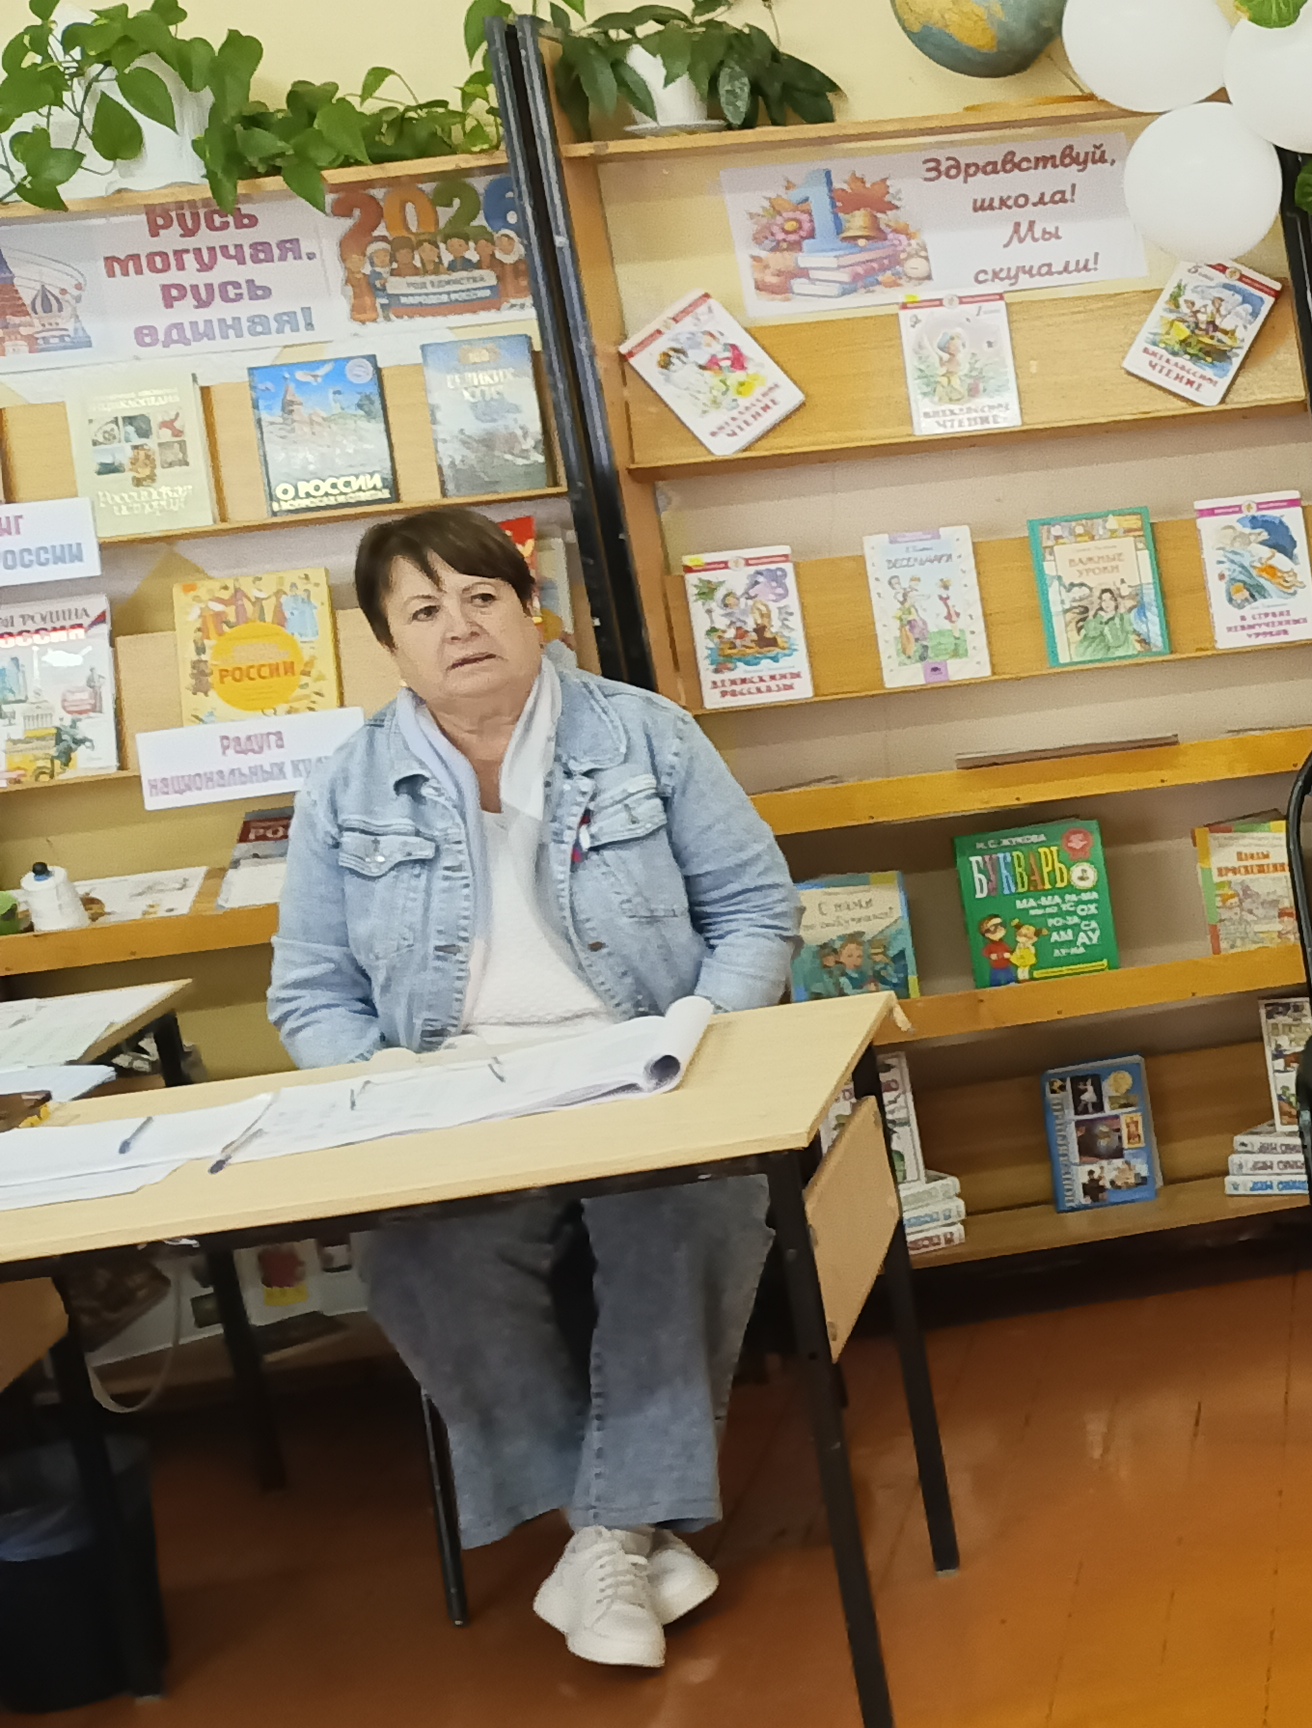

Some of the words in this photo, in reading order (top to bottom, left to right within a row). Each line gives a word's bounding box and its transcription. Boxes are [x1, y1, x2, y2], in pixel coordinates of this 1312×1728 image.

[921, 143, 1116, 184] Здравствуй,
[972, 183, 1076, 213] школа!
[1003, 220, 1062, 248] Мы
[974, 252, 1099, 287] скучали!
[134, 307, 315, 348] единая!
[1148, 360, 1203, 392] ЧТЕНИЕ
[726, 398, 780, 438] ЧТЕНИЕ
[275, 483, 295, 500] О
[297, 473, 383, 498] РОССИИ
[1068, 552, 1125, 568] ВАЖНЫЕ
[1076, 564, 1120, 578] УРОКИ
[218, 661, 296, 684] РОССИИ
[219, 731, 285, 756] Радуга
[968, 846, 1068, 899] БУКВАРЬ
[1076, 903, 1099, 916] ОХ
